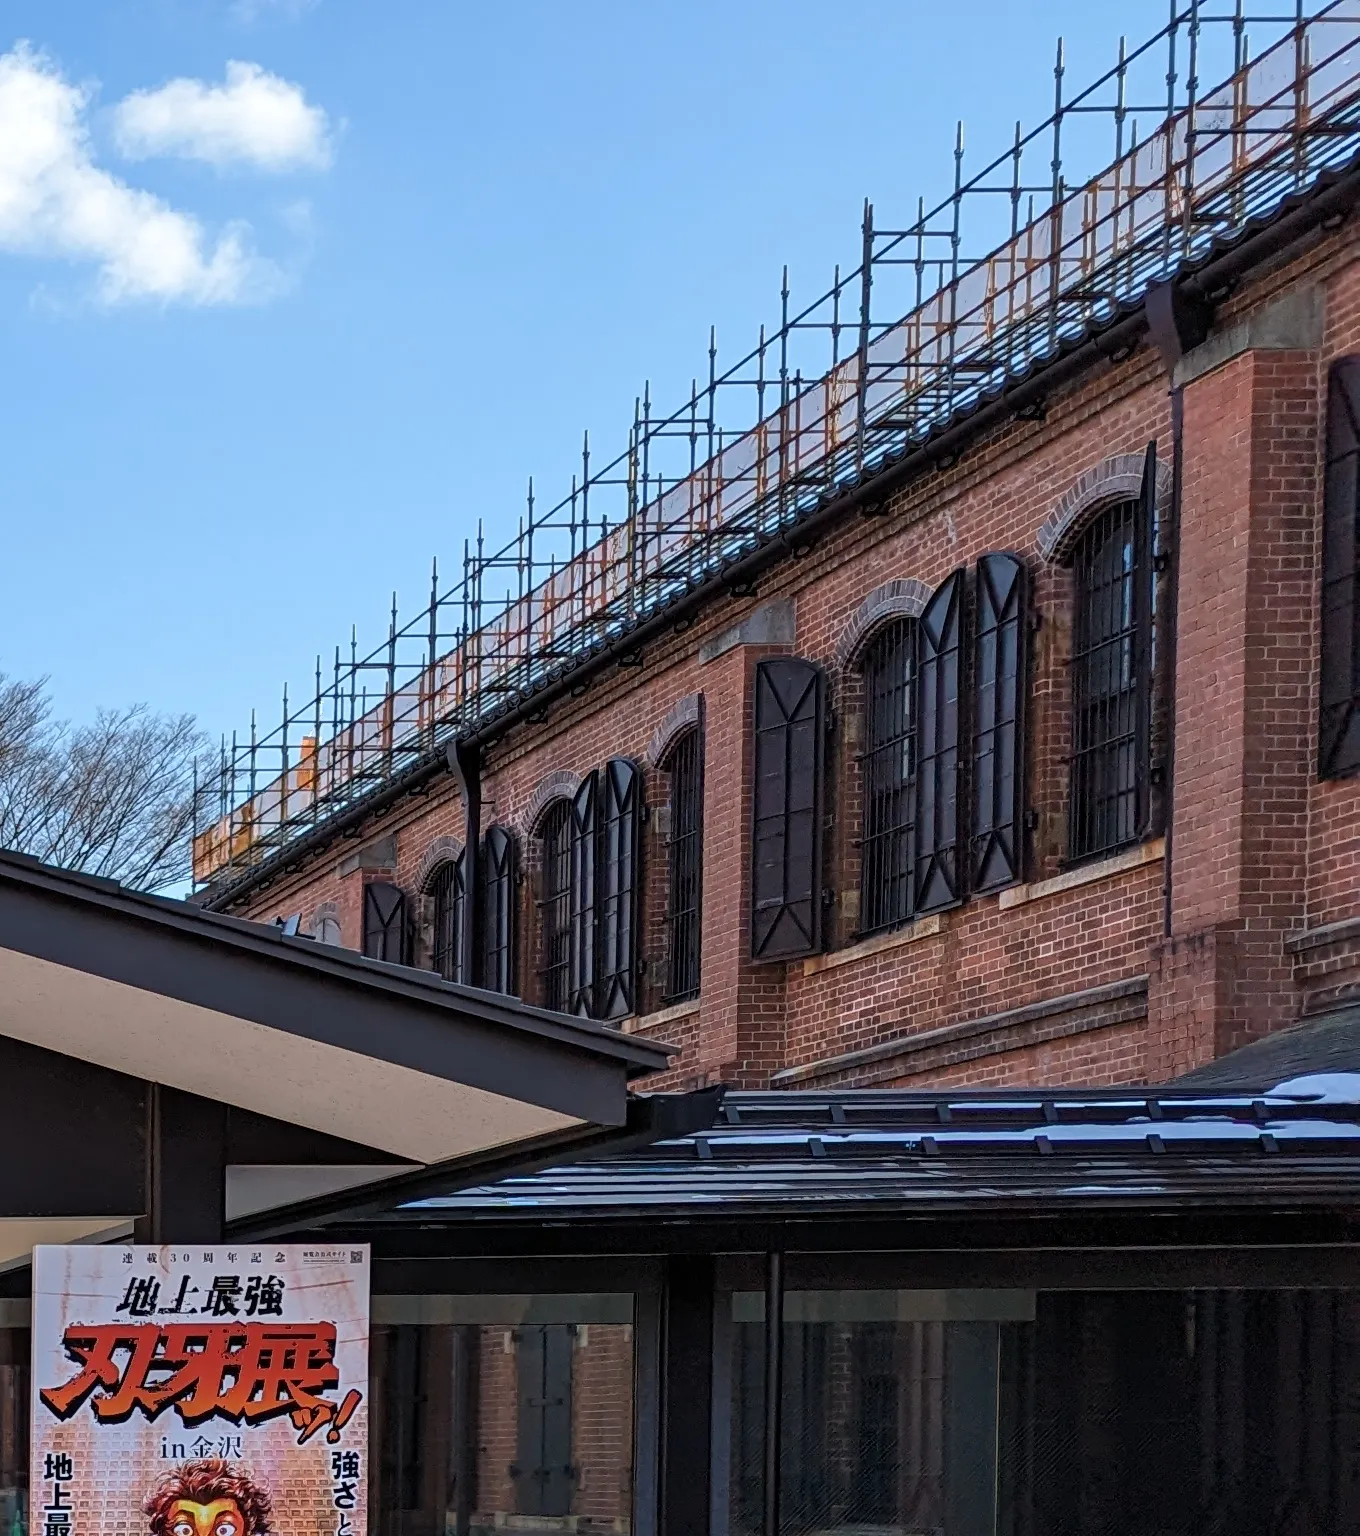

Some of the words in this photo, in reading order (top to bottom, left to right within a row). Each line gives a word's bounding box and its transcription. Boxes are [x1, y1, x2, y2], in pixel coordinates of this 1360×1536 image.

[121, 1251, 287, 1264] 連載30周年記念
[115, 1274, 286, 1318] 地上最強
[160, 1435, 243, 1460] in金沢
